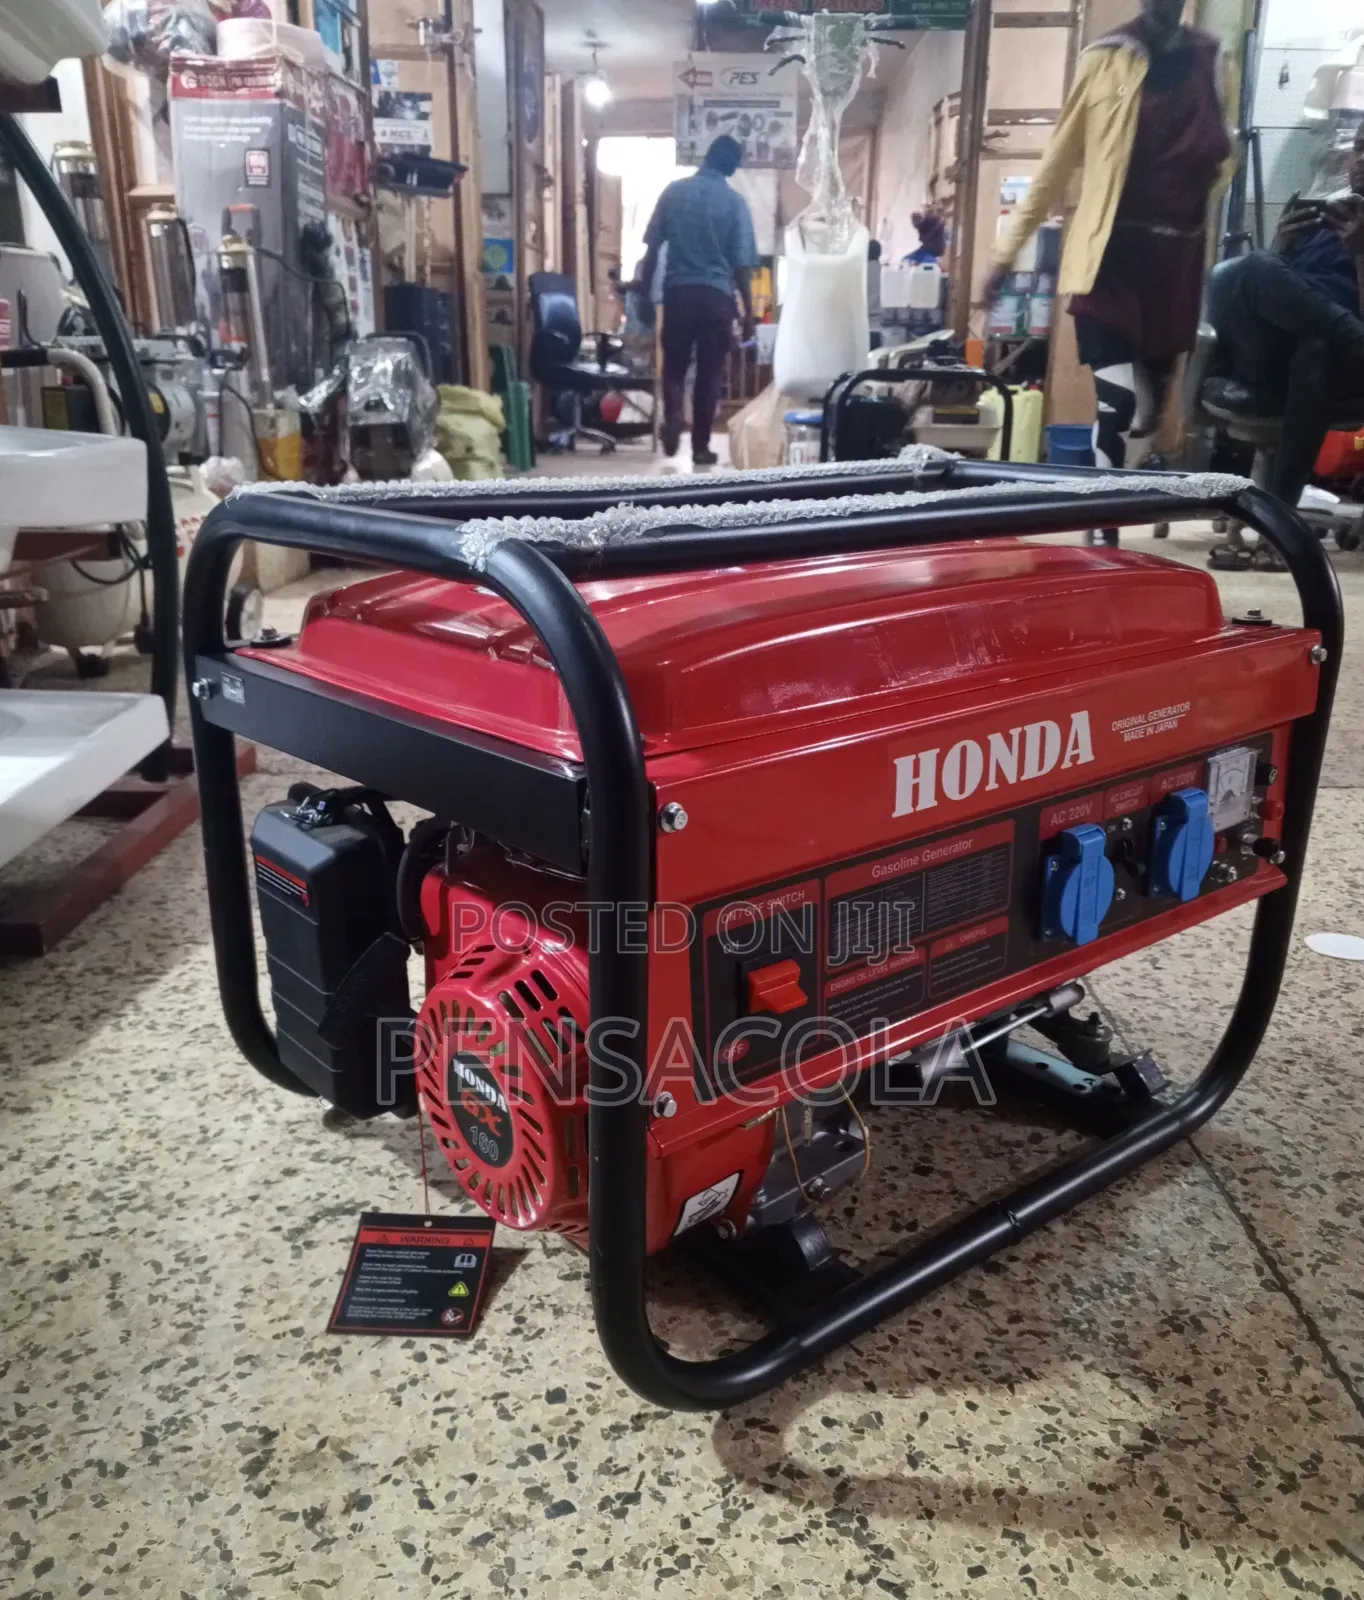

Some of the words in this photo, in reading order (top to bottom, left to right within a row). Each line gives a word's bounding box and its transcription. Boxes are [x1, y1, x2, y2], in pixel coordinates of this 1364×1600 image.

[729, 71, 760, 84] PES
[1111, 714, 1146, 732] ORIGINAL
[1147, 701, 1191, 721] GENERATOR
[1123, 728, 1145, 743] MADE
[1146, 725, 1154, 737] IN
[1154, 719, 1179, 734] JAPAN
[891, 710, 1095, 819] HONDA
[1160, 777, 1174, 790] AC
[1050, 810, 1066, 827] AC
[1068, 800, 1093, 820] 220V
[871, 856, 920, 879] Gasoline
[921, 837, 973, 863] Generator
[720, 911, 737, 925] ON
[744, 903, 765, 918] OFF
[766, 889, 805, 911] SWITCH
[722, 939, 740, 954] ON
[830, 976, 857, 992] ENGINE
[856, 972, 867, 981] OIL
[868, 964, 889, 978] LEVEL
[889, 953, 920, 969] WARNING
[722, 1042, 744, 1061] OFF
[452, 1058, 509, 1114] HONDA
[460, 1089, 503, 1138] GX
[400, 1235, 451, 1245] WARNING
